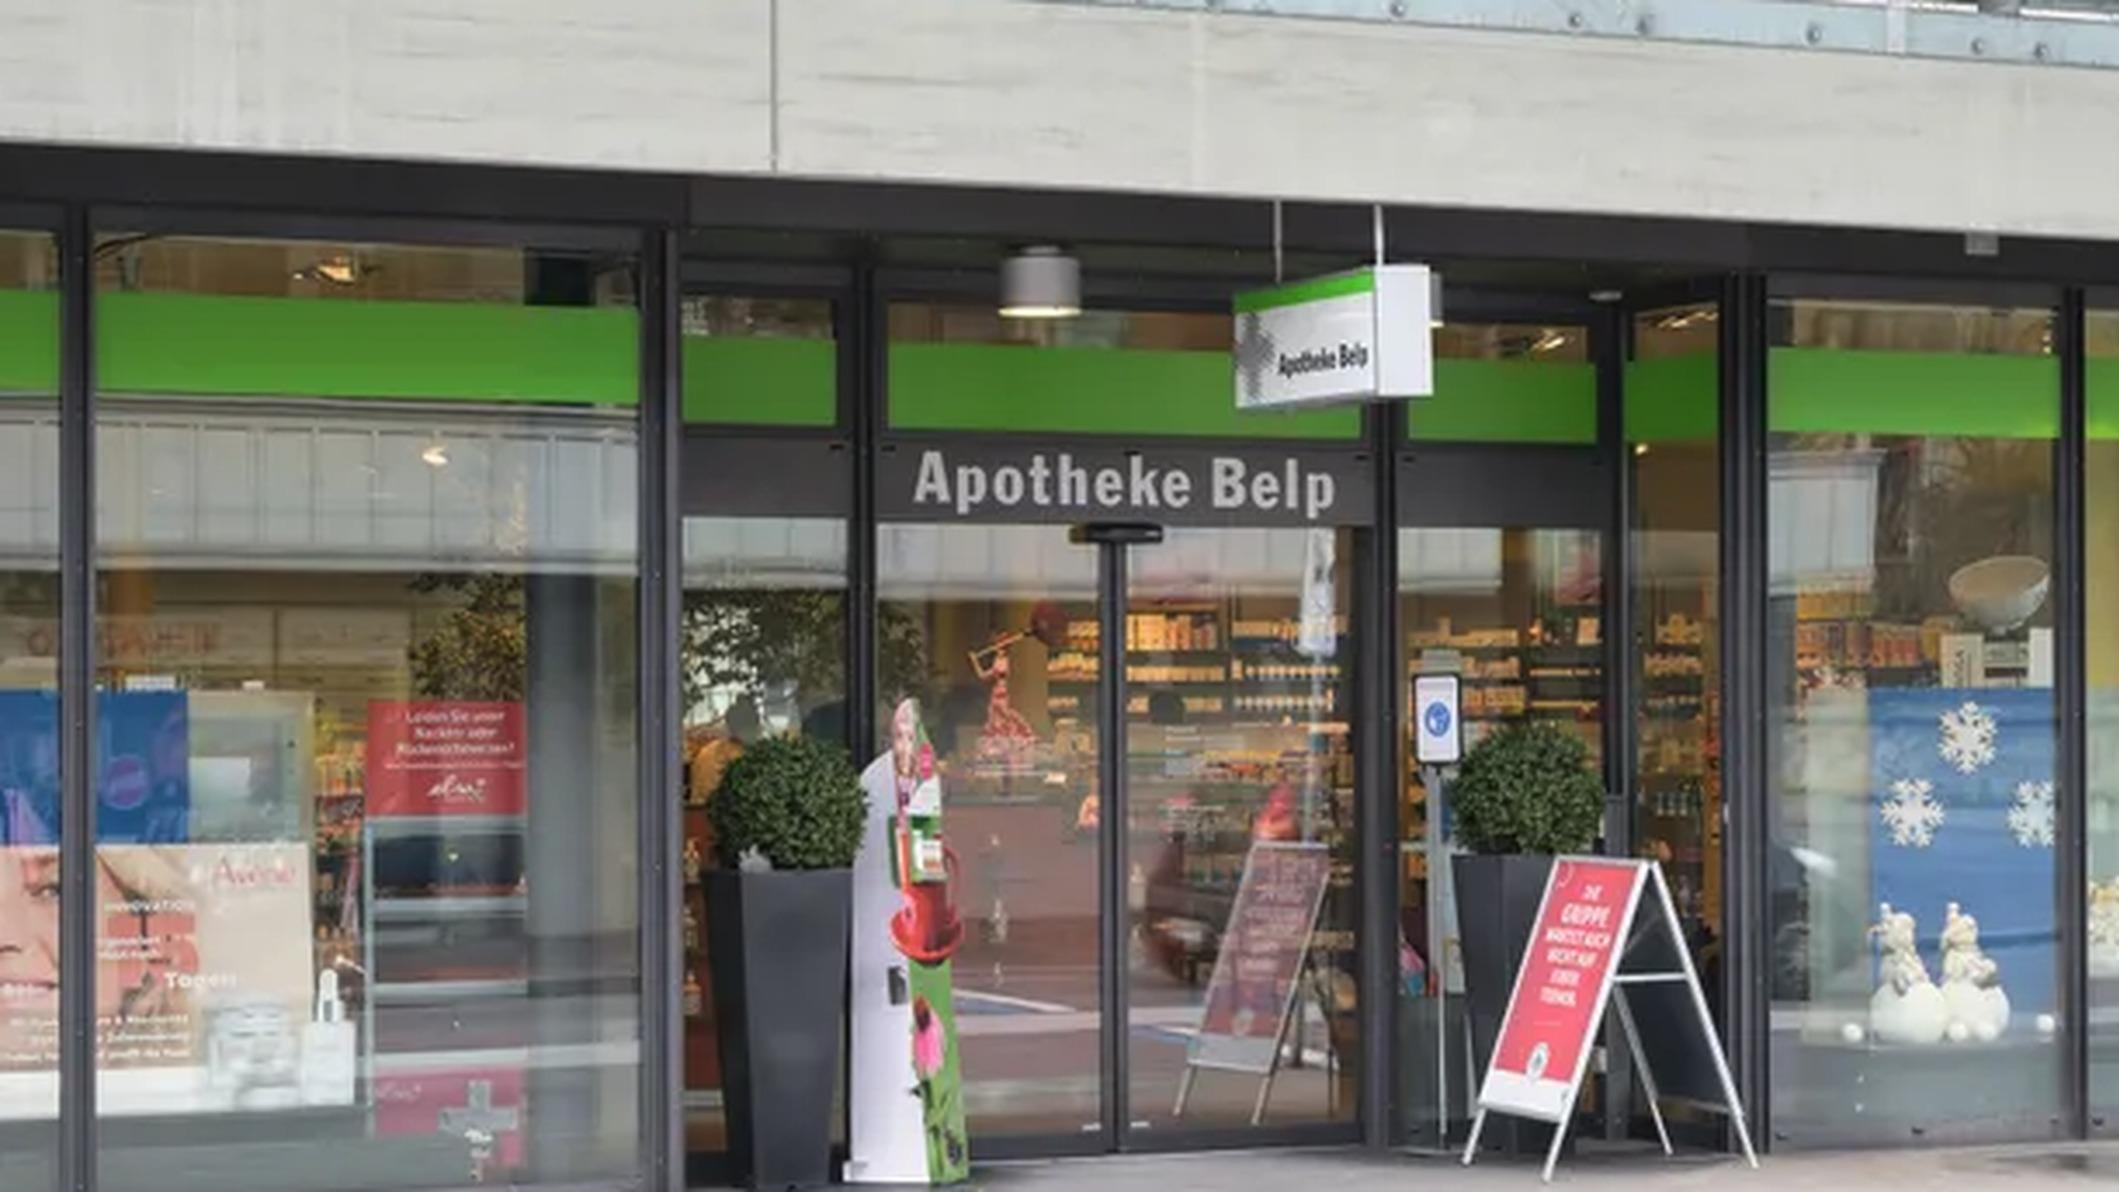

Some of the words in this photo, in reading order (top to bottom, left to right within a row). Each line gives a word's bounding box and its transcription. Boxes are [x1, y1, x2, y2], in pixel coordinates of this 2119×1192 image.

[1278, 347, 1336, 379] Apotheke
[1339, 342, 1368, 369] Belp
[914, 450, 1192, 514] Apotheke
[1212, 457, 1336, 519] Belp
[1561, 902, 1612, 928] GRIPPE
